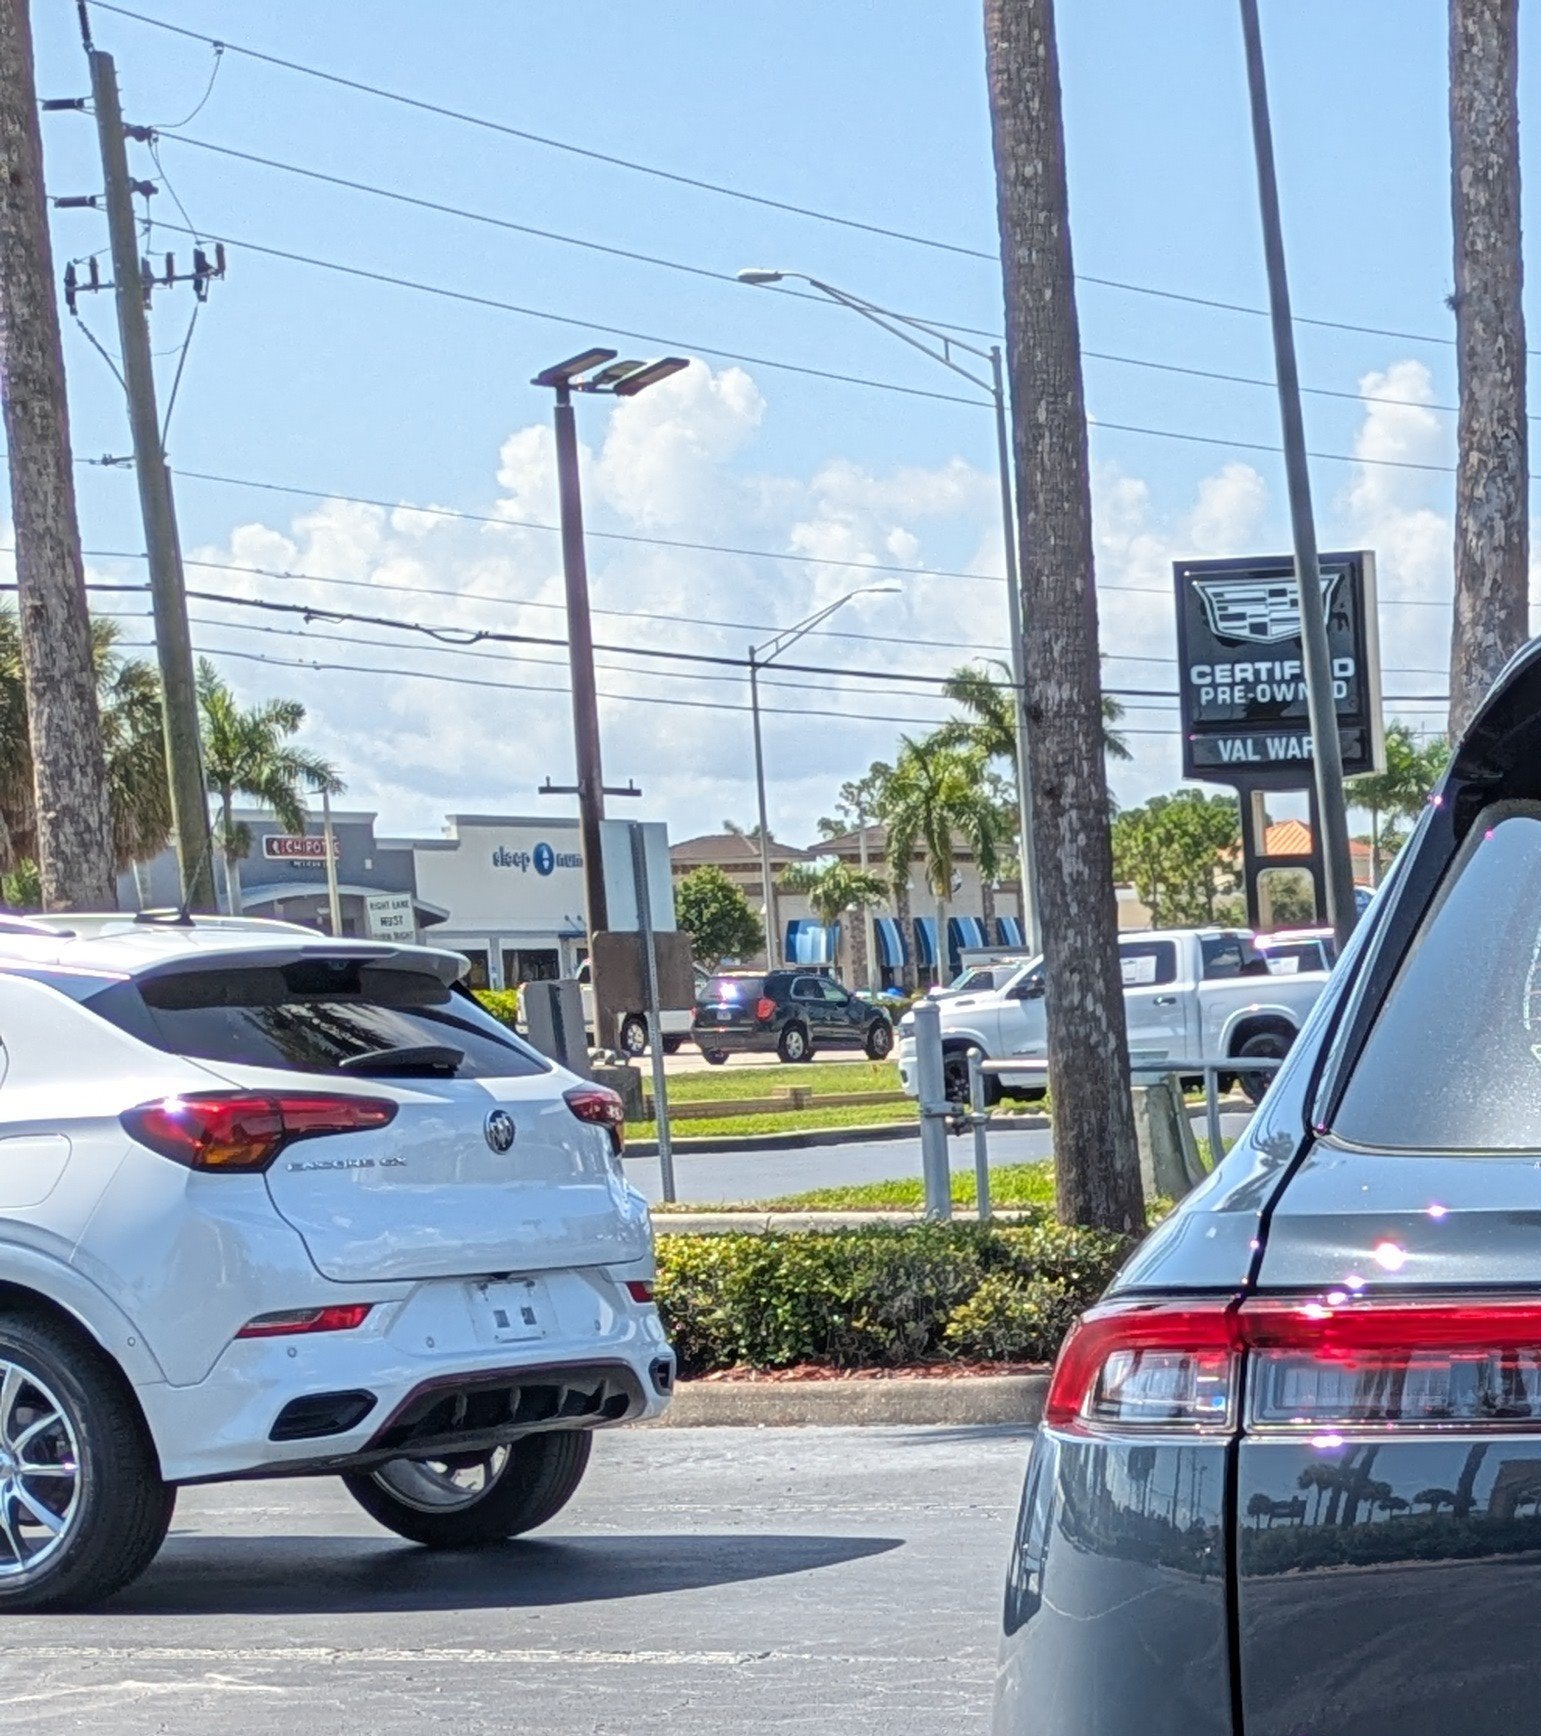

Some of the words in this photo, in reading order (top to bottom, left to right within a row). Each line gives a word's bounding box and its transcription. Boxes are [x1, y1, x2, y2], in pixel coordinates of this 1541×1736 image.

[1190, 658, 1356, 685] CERTIFD
[1200, 680, 1348, 705] PRE-OWND
[1218, 738, 1261, 762] VAL
[1266, 736, 1316, 760] WAR
[286, 840, 340, 854] CHIPOTE
[492, 845, 531, 873] sleep
[370, 901, 390, 910] RIGHT
[381, 915, 403, 926] MUST
